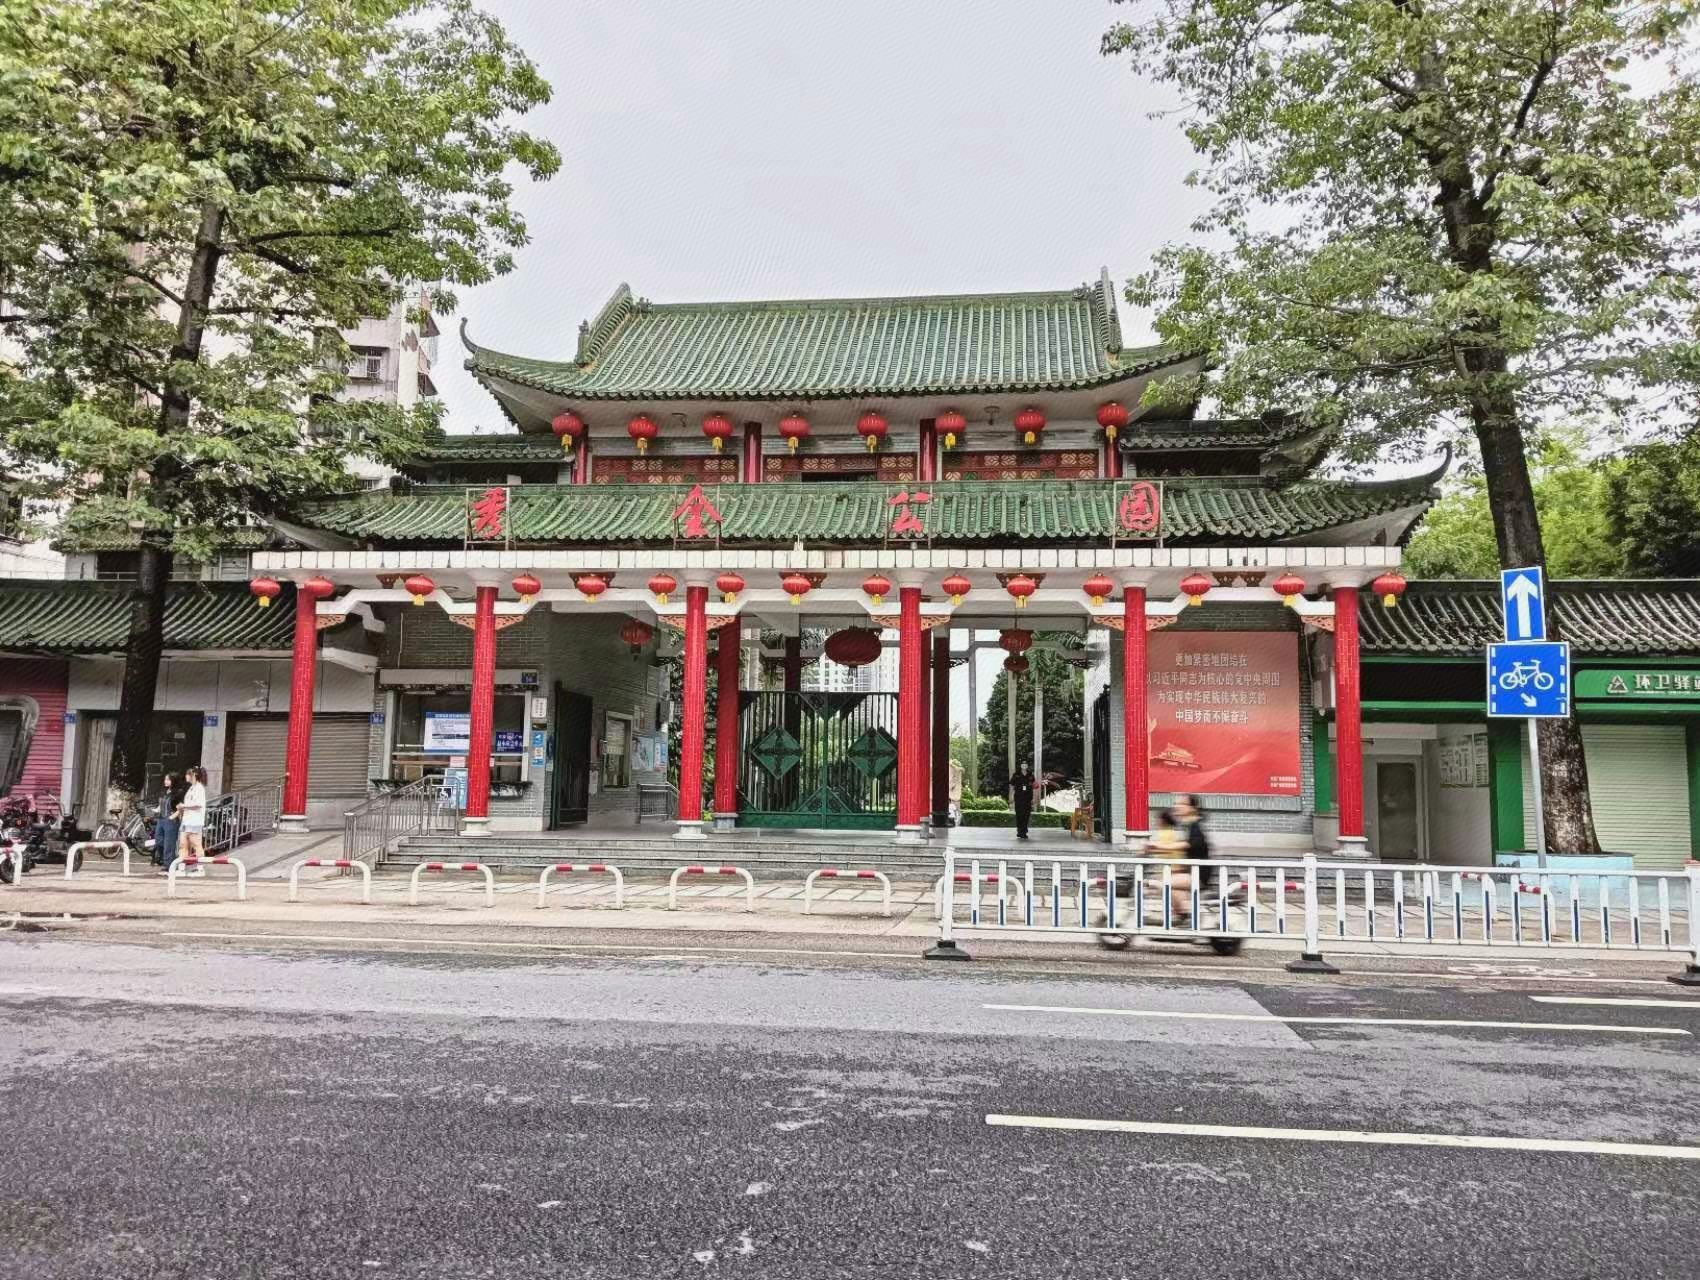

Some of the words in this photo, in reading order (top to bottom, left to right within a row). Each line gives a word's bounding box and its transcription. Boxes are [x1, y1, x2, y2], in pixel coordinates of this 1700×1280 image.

[1175, 709, 1248, 724] 中国梦而不懈奋斗
